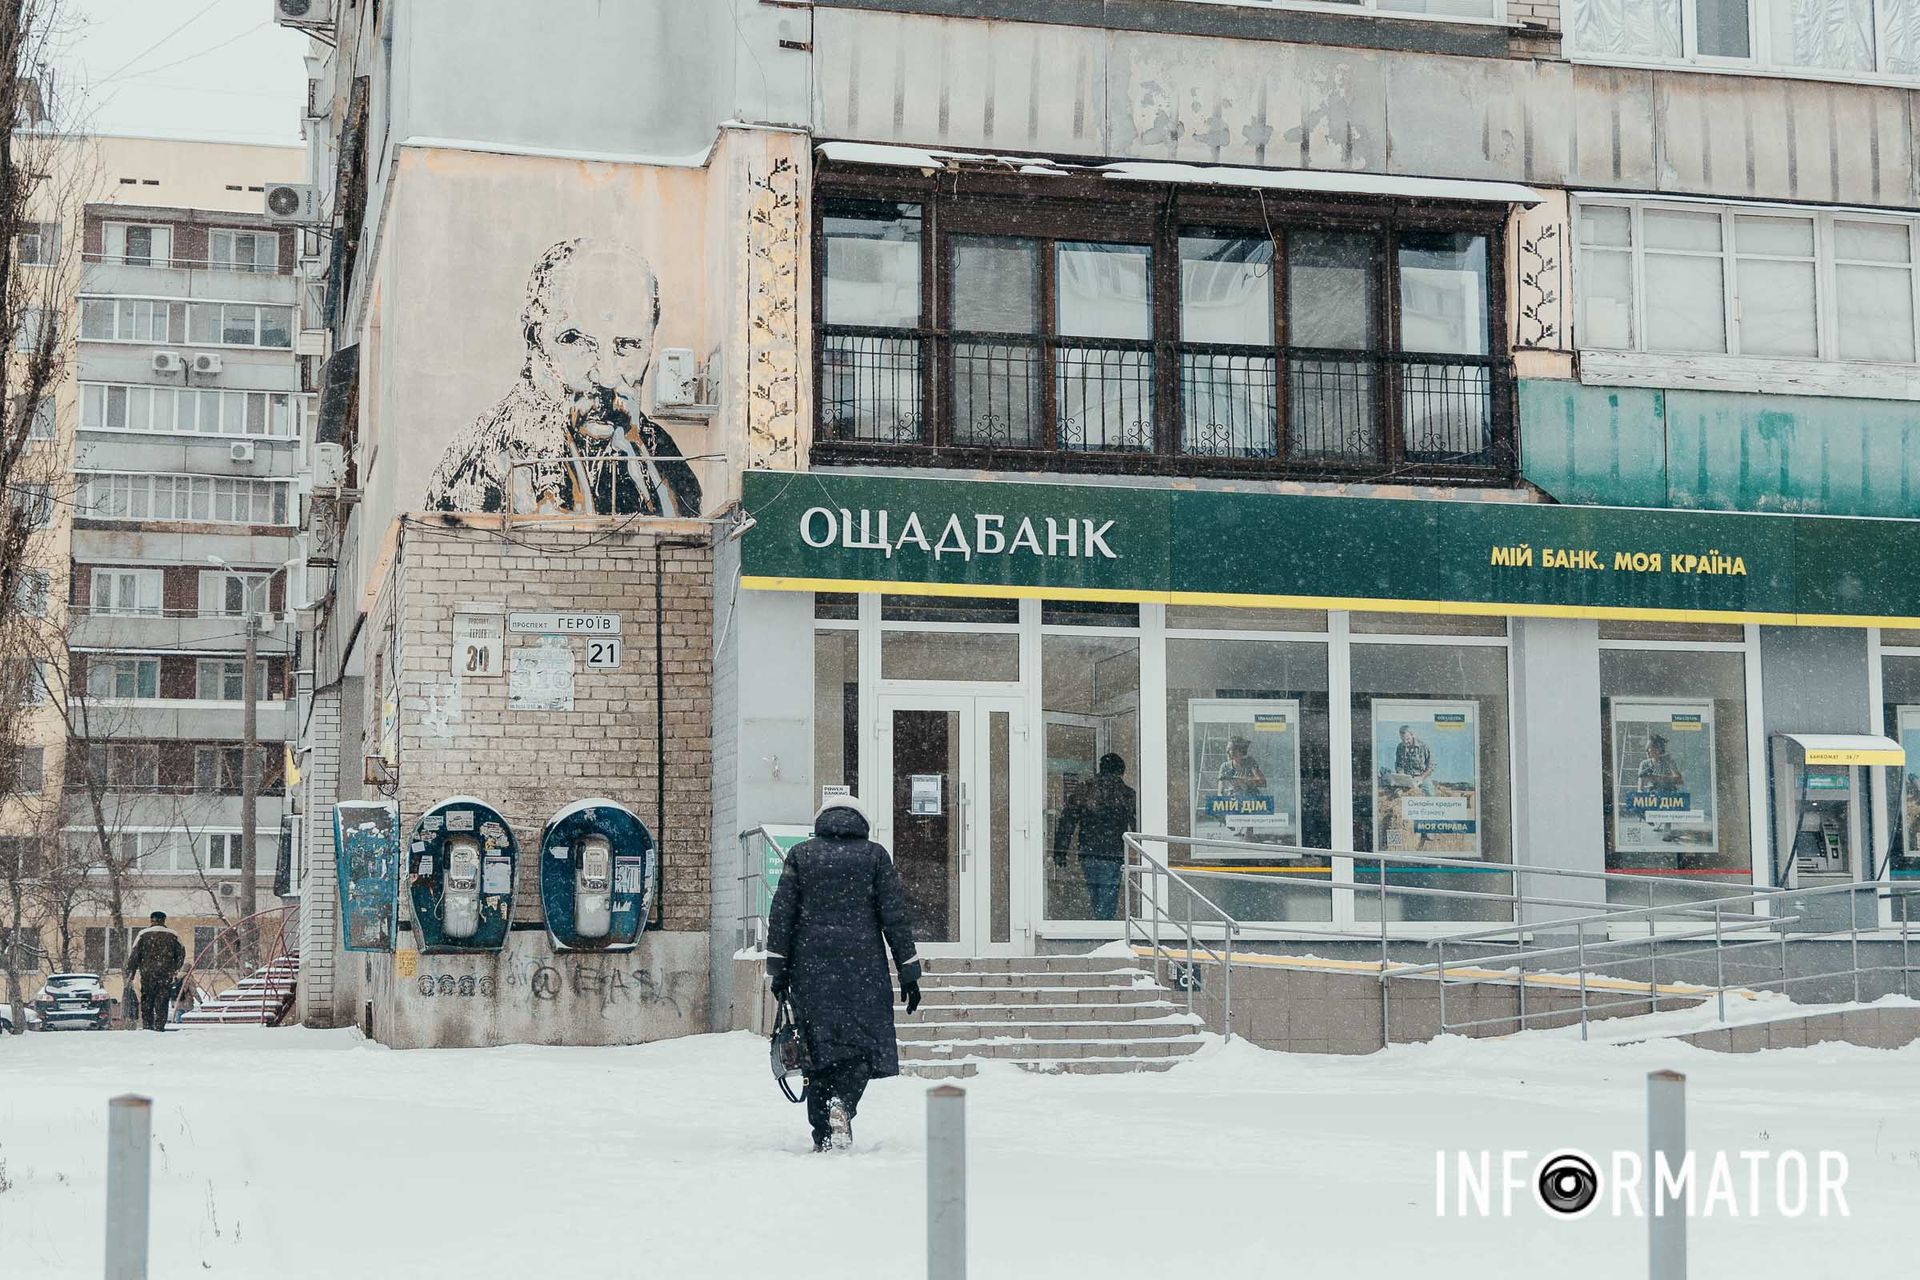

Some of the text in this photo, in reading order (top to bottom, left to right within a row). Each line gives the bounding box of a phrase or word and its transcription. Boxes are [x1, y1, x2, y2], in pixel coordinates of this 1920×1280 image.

[799, 506, 1117, 561] ОЩАДБАНК
[1490, 543, 1747, 576] МІЙ БАНК. МОЯ КРАЇНА
[557, 616, 611, 630] ГЕРОЇВ
[589, 643, 615, 663] 21
[1212, 797, 1267, 813] МІЙ ДІМ
[1633, 794, 1684, 809] МІЙ ДІМ
[1417, 823, 1468, 831] МОЯ СПРАВА
